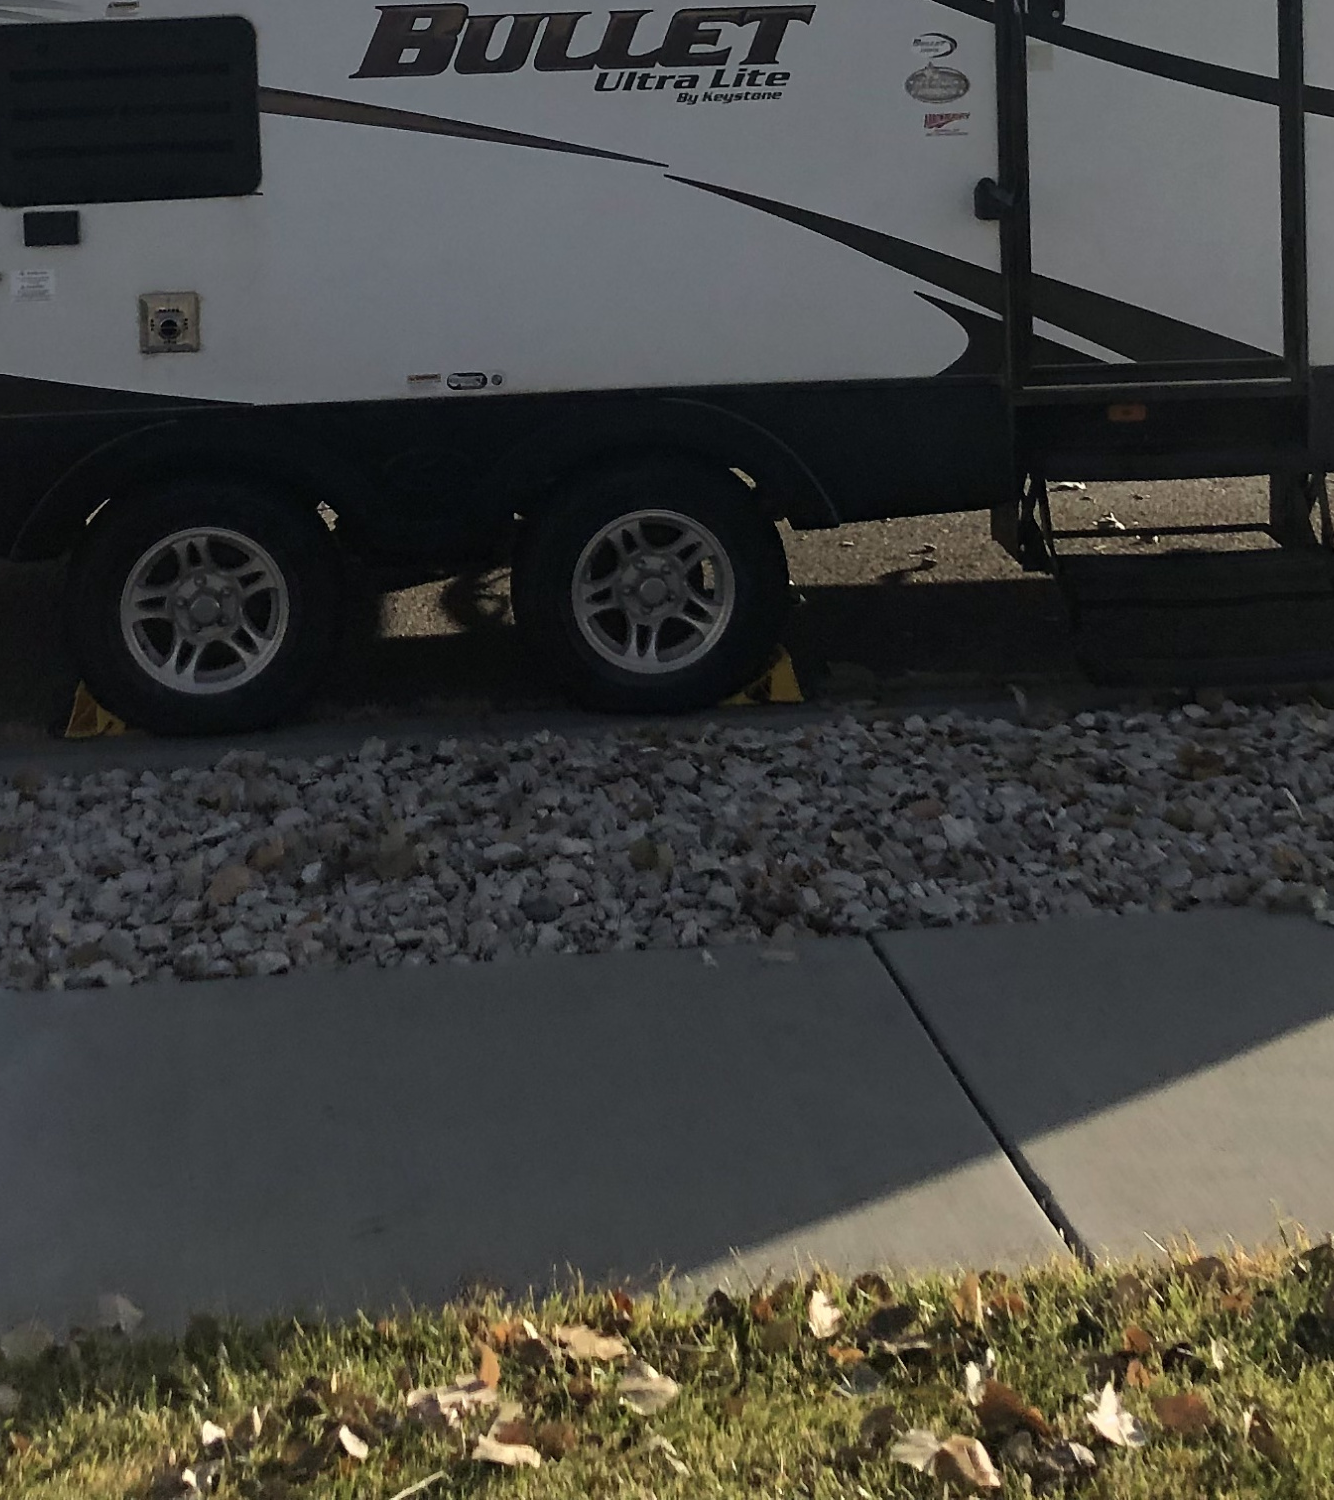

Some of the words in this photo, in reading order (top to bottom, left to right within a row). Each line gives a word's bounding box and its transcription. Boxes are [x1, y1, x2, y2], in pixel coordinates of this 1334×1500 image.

[349, 3, 817, 79] BULLET
[593, 71, 700, 92] Ultra
[709, 68, 791, 89] Lite
[676, 91, 699, 106] By
[702, 91, 783, 104] Keystone
